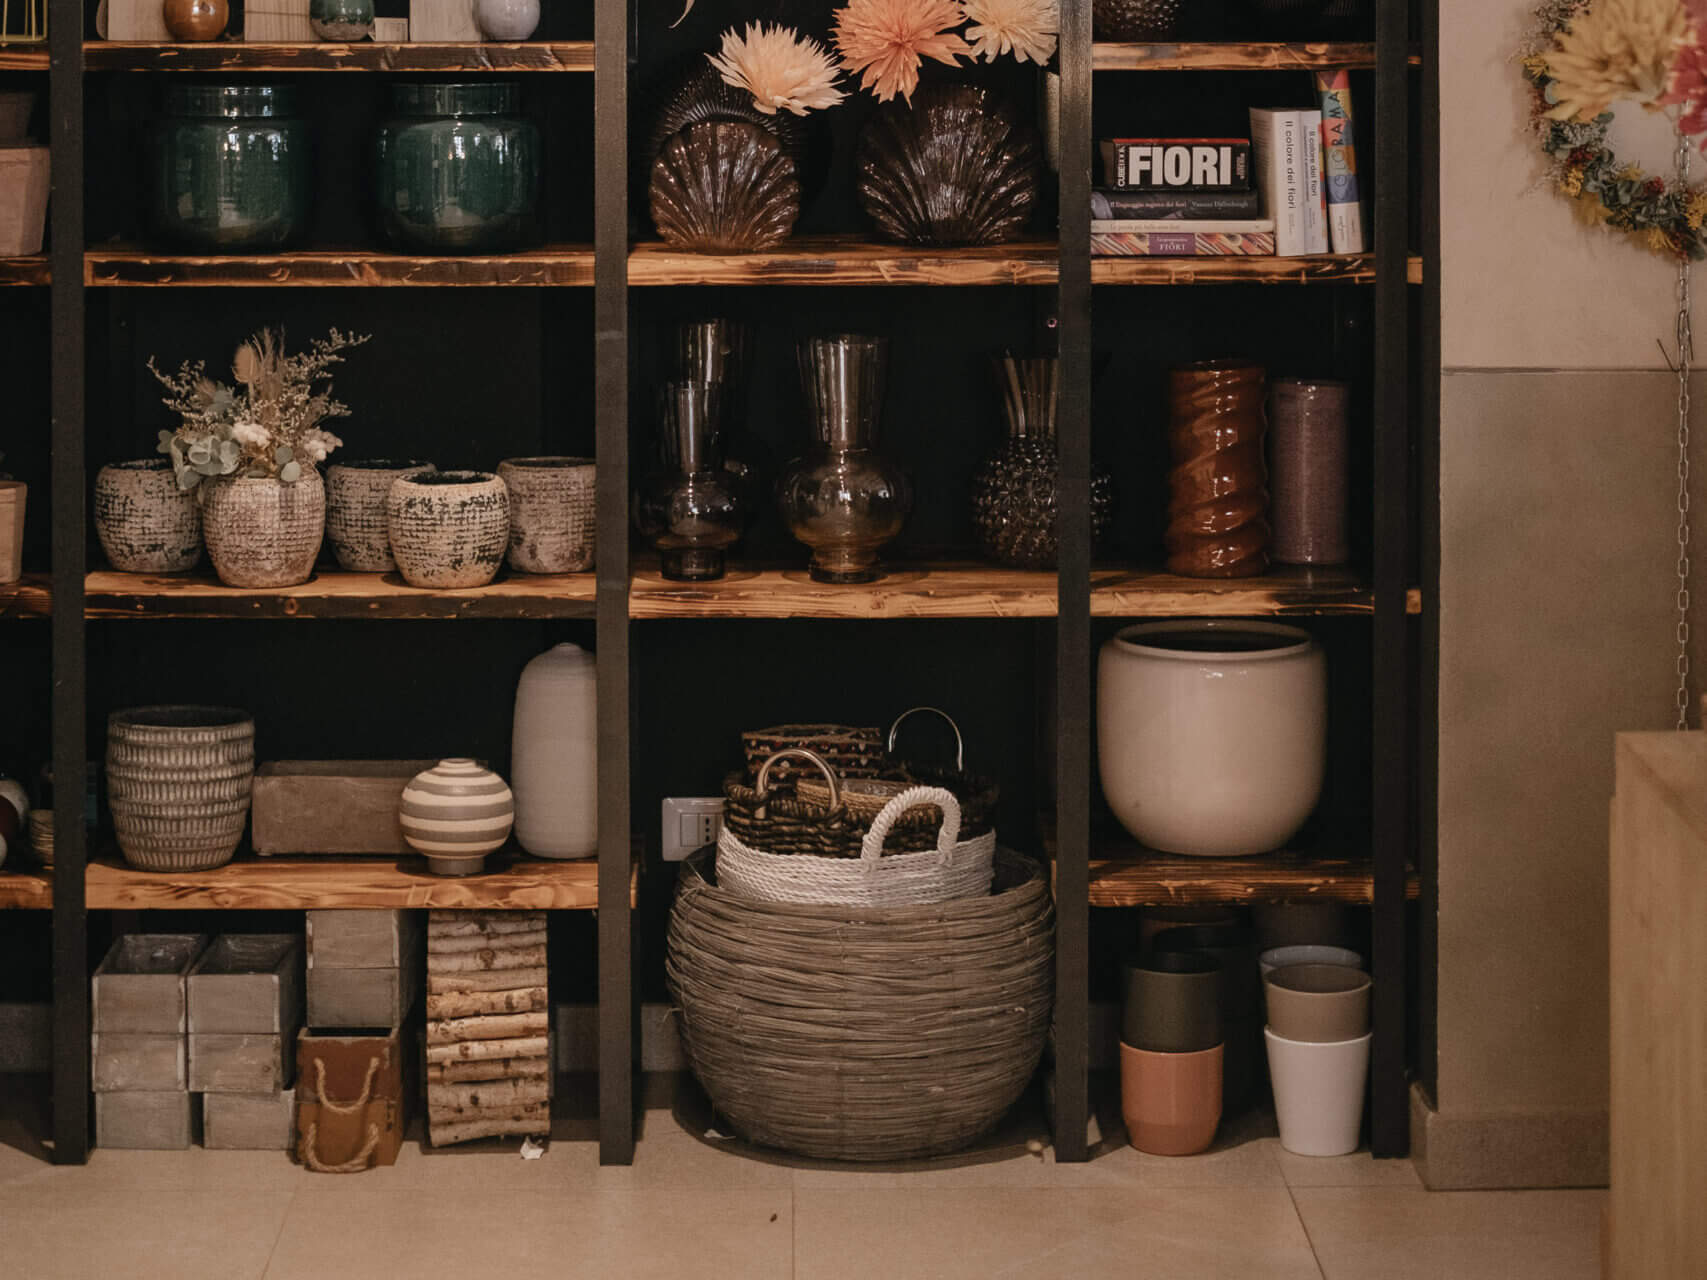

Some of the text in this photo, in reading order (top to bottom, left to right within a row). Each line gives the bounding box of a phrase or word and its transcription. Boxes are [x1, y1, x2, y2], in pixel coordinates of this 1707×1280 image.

[1286, 130, 1294, 164] colore
[1328, 91, 1348, 202] COLORAMA
[1128, 146, 1231, 185] FIORI
[1287, 167, 1295, 184] dei
[1288, 188, 1296, 209] fiori
